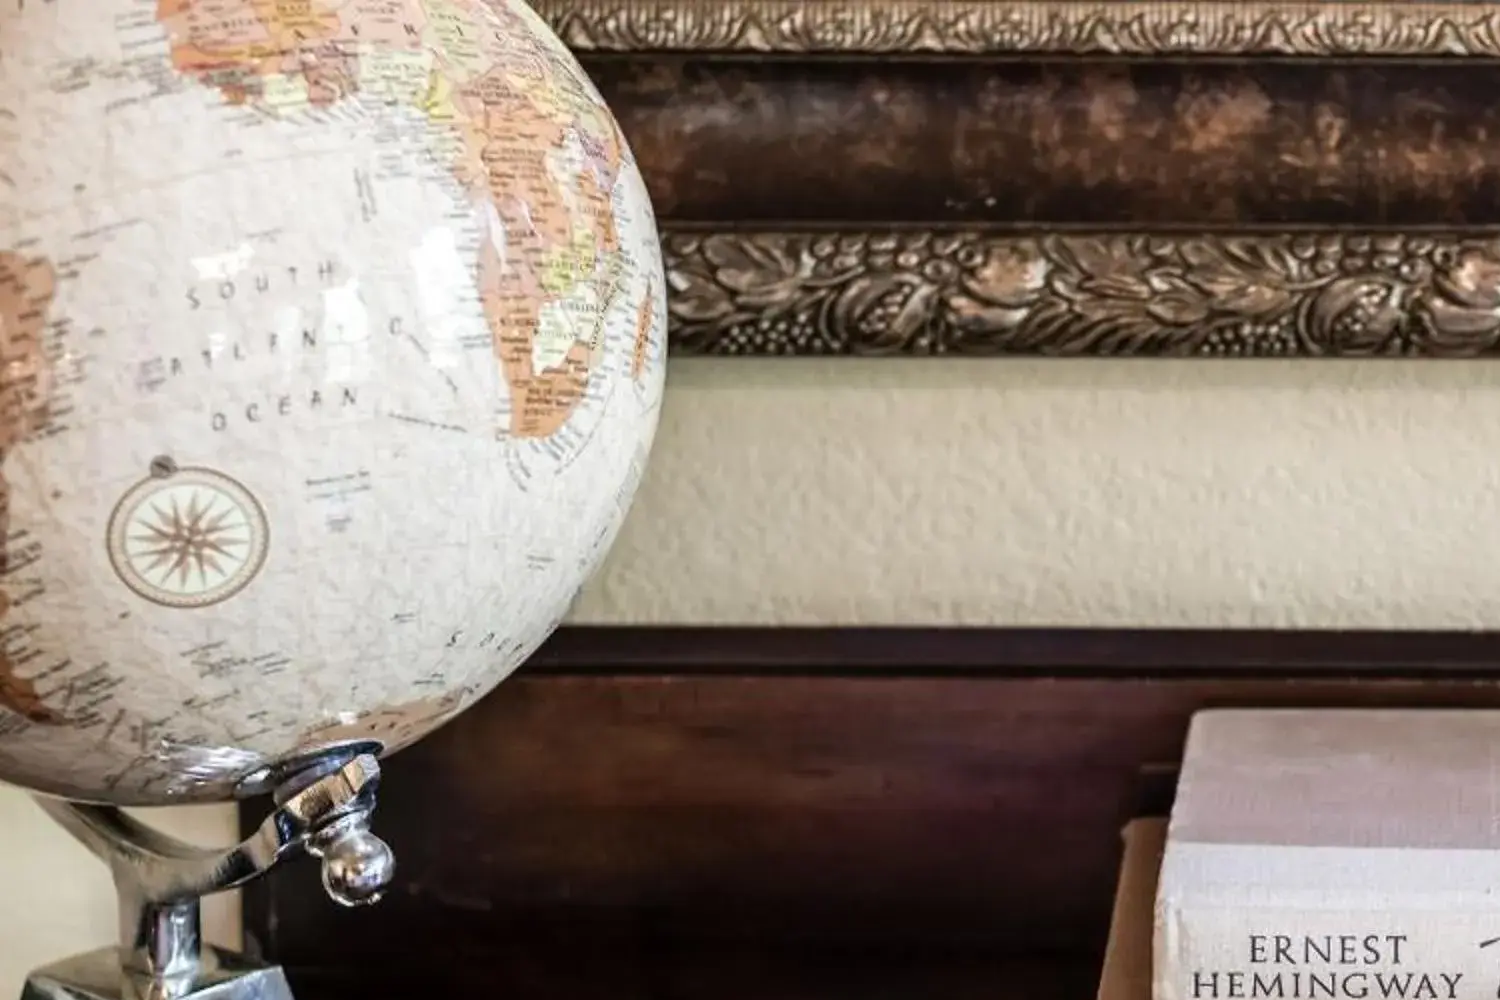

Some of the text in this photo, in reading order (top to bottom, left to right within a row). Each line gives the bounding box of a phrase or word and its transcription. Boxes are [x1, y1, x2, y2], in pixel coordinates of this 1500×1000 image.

[185, 260, 334, 311] SOUTH
[170, 316, 403, 376] ATLANC
[211, 386, 357, 431] OCEAN
[1249, 934, 1408, 965] ERNEST
[1192, 971, 1465, 999] HEMINGWAY
